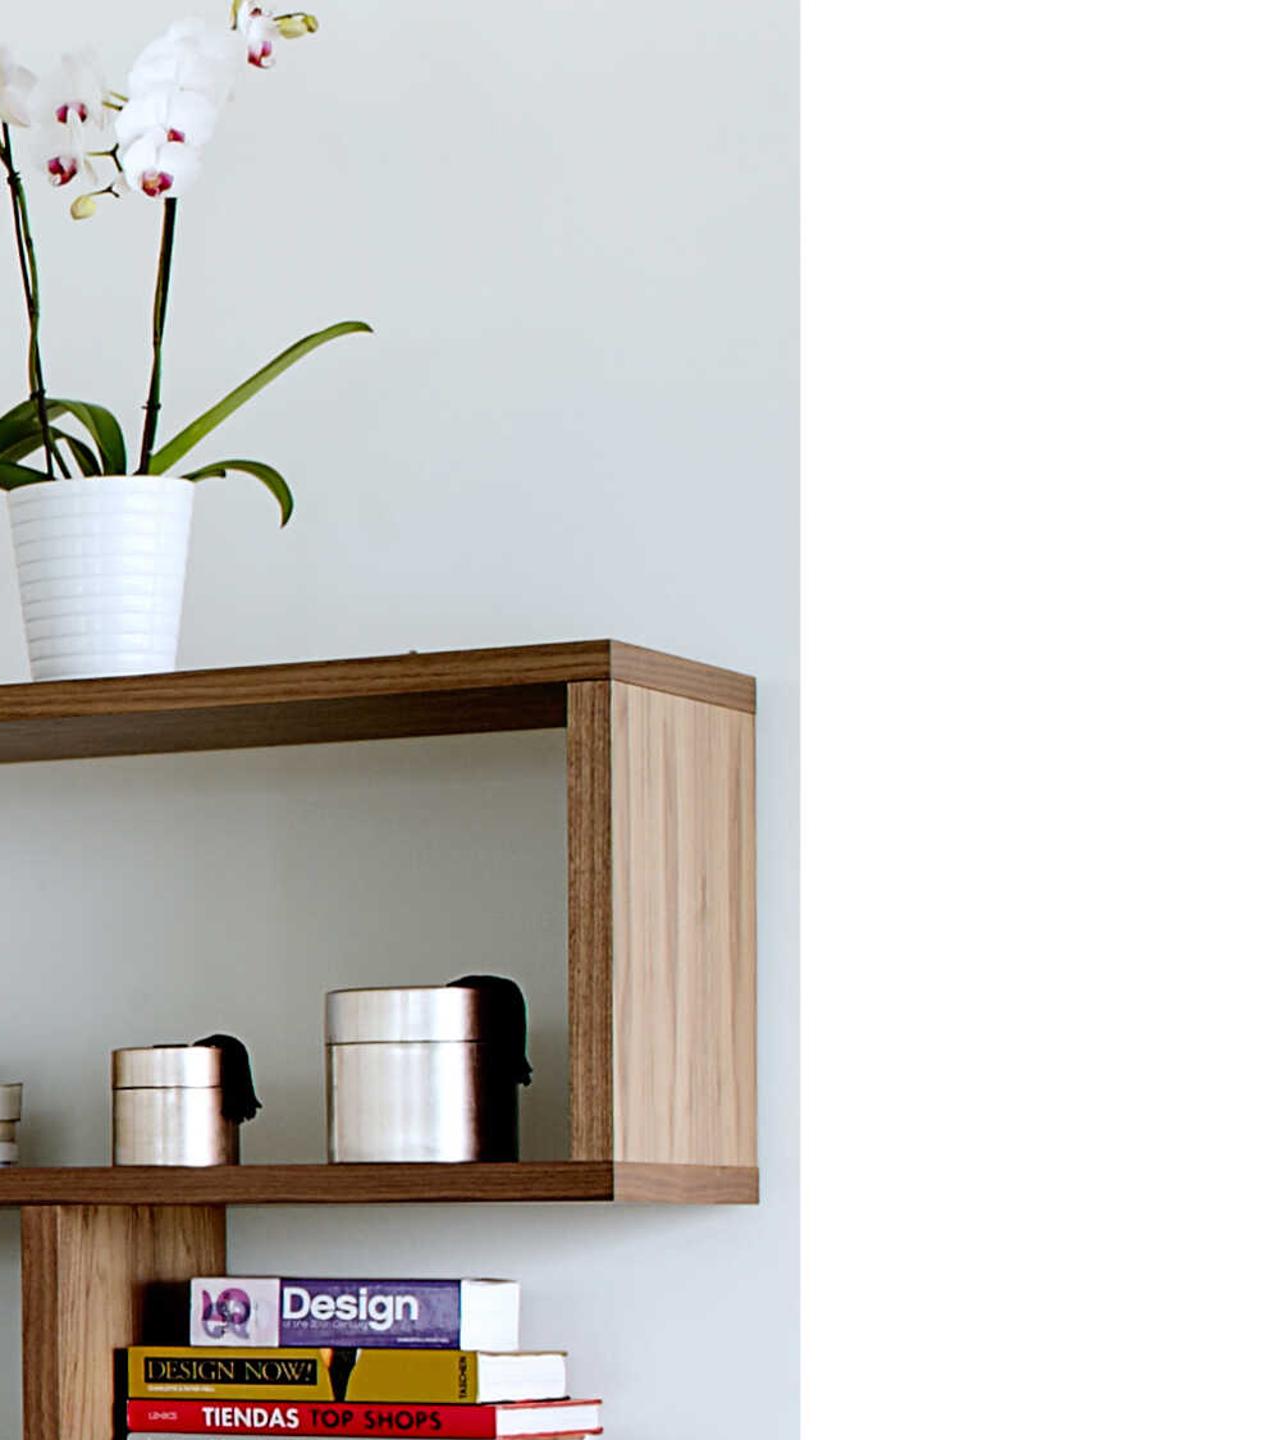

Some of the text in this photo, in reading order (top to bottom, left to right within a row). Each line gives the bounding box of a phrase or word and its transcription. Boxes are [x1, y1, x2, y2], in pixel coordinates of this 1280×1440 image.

[283, 1287, 418, 1331] Design
[147, 1360, 313, 1382] DESIGN NOW!
[202, 1406, 443, 1431] TIENDAS TOP SHOPS
